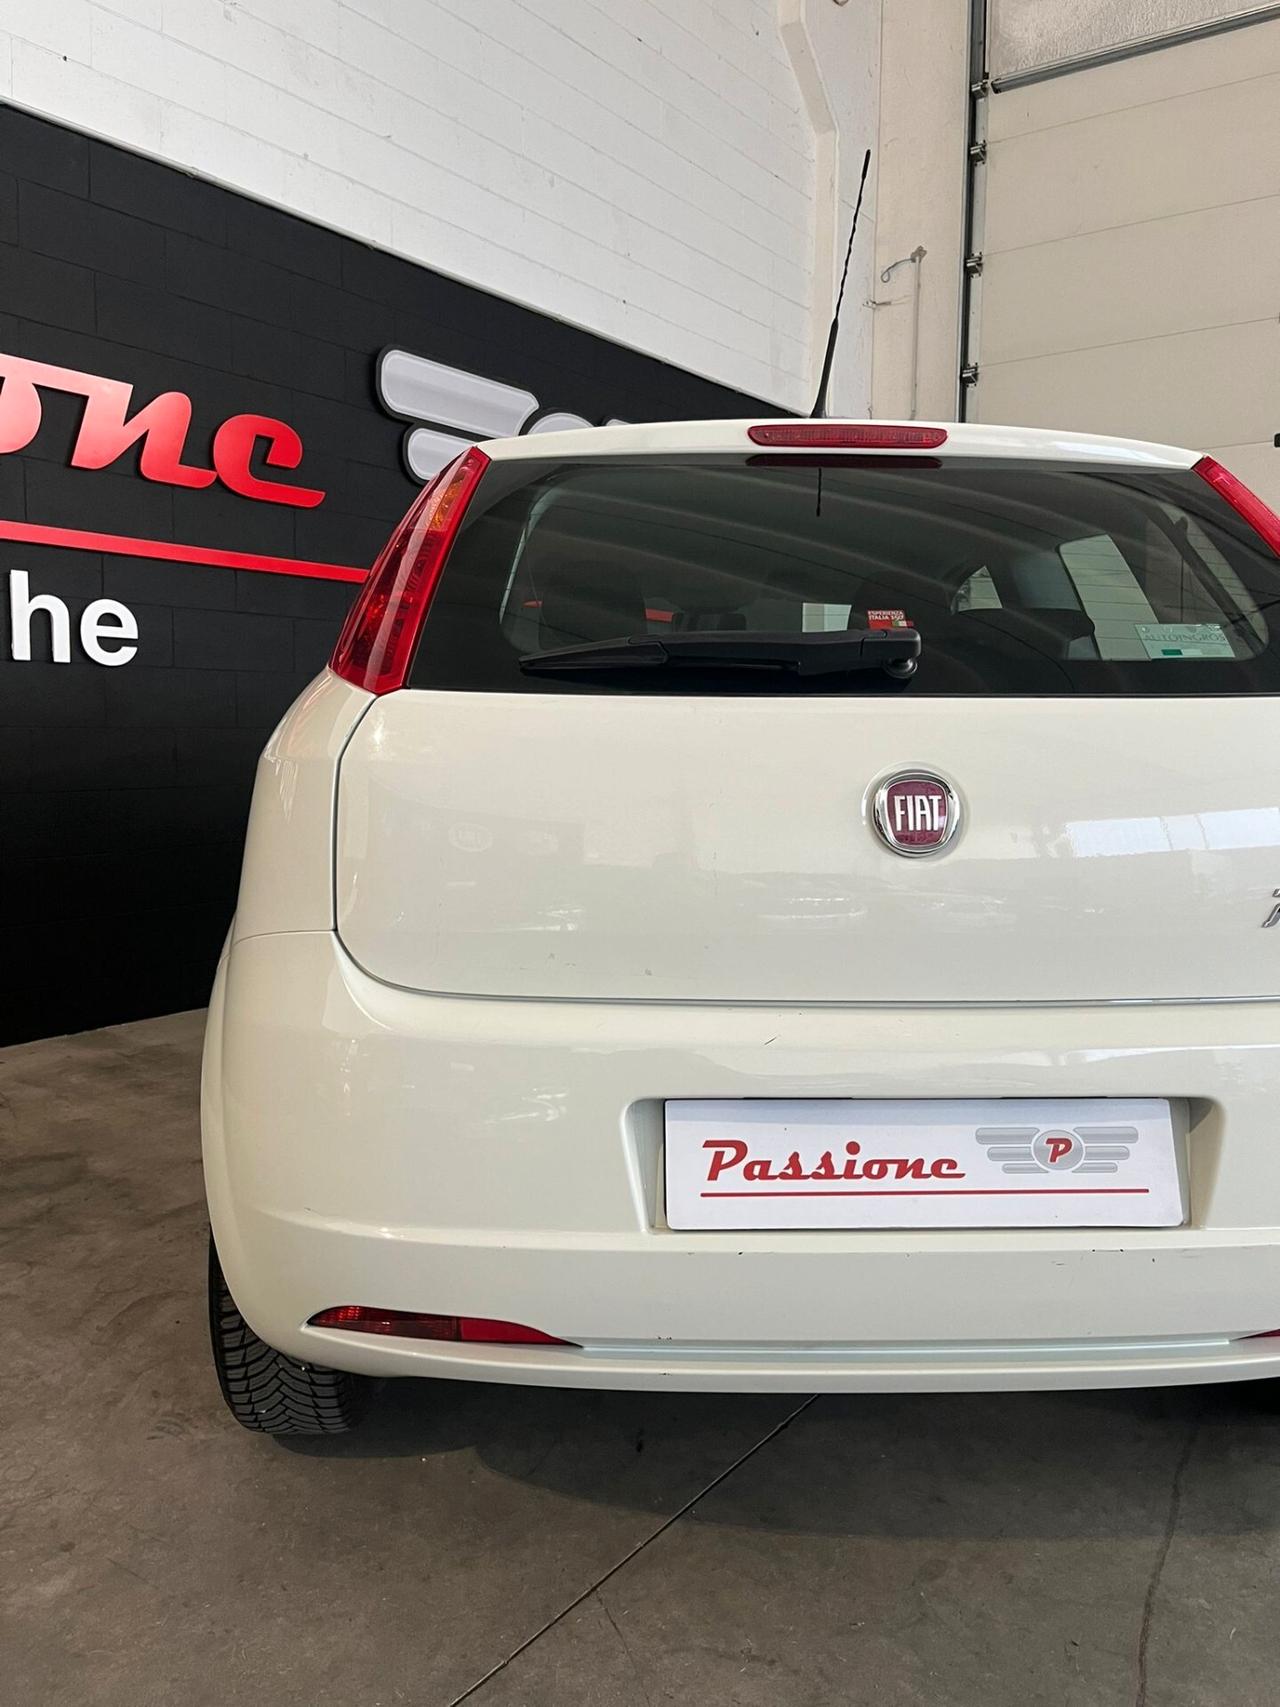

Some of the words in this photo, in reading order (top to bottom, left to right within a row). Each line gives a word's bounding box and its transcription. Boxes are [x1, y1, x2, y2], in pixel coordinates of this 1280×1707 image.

[10, 569, 139, 667] he
[894, 795, 942, 832] FIAT
[702, 1140, 965, 1181] Passione
[1045, 1138, 1072, 1164] P
